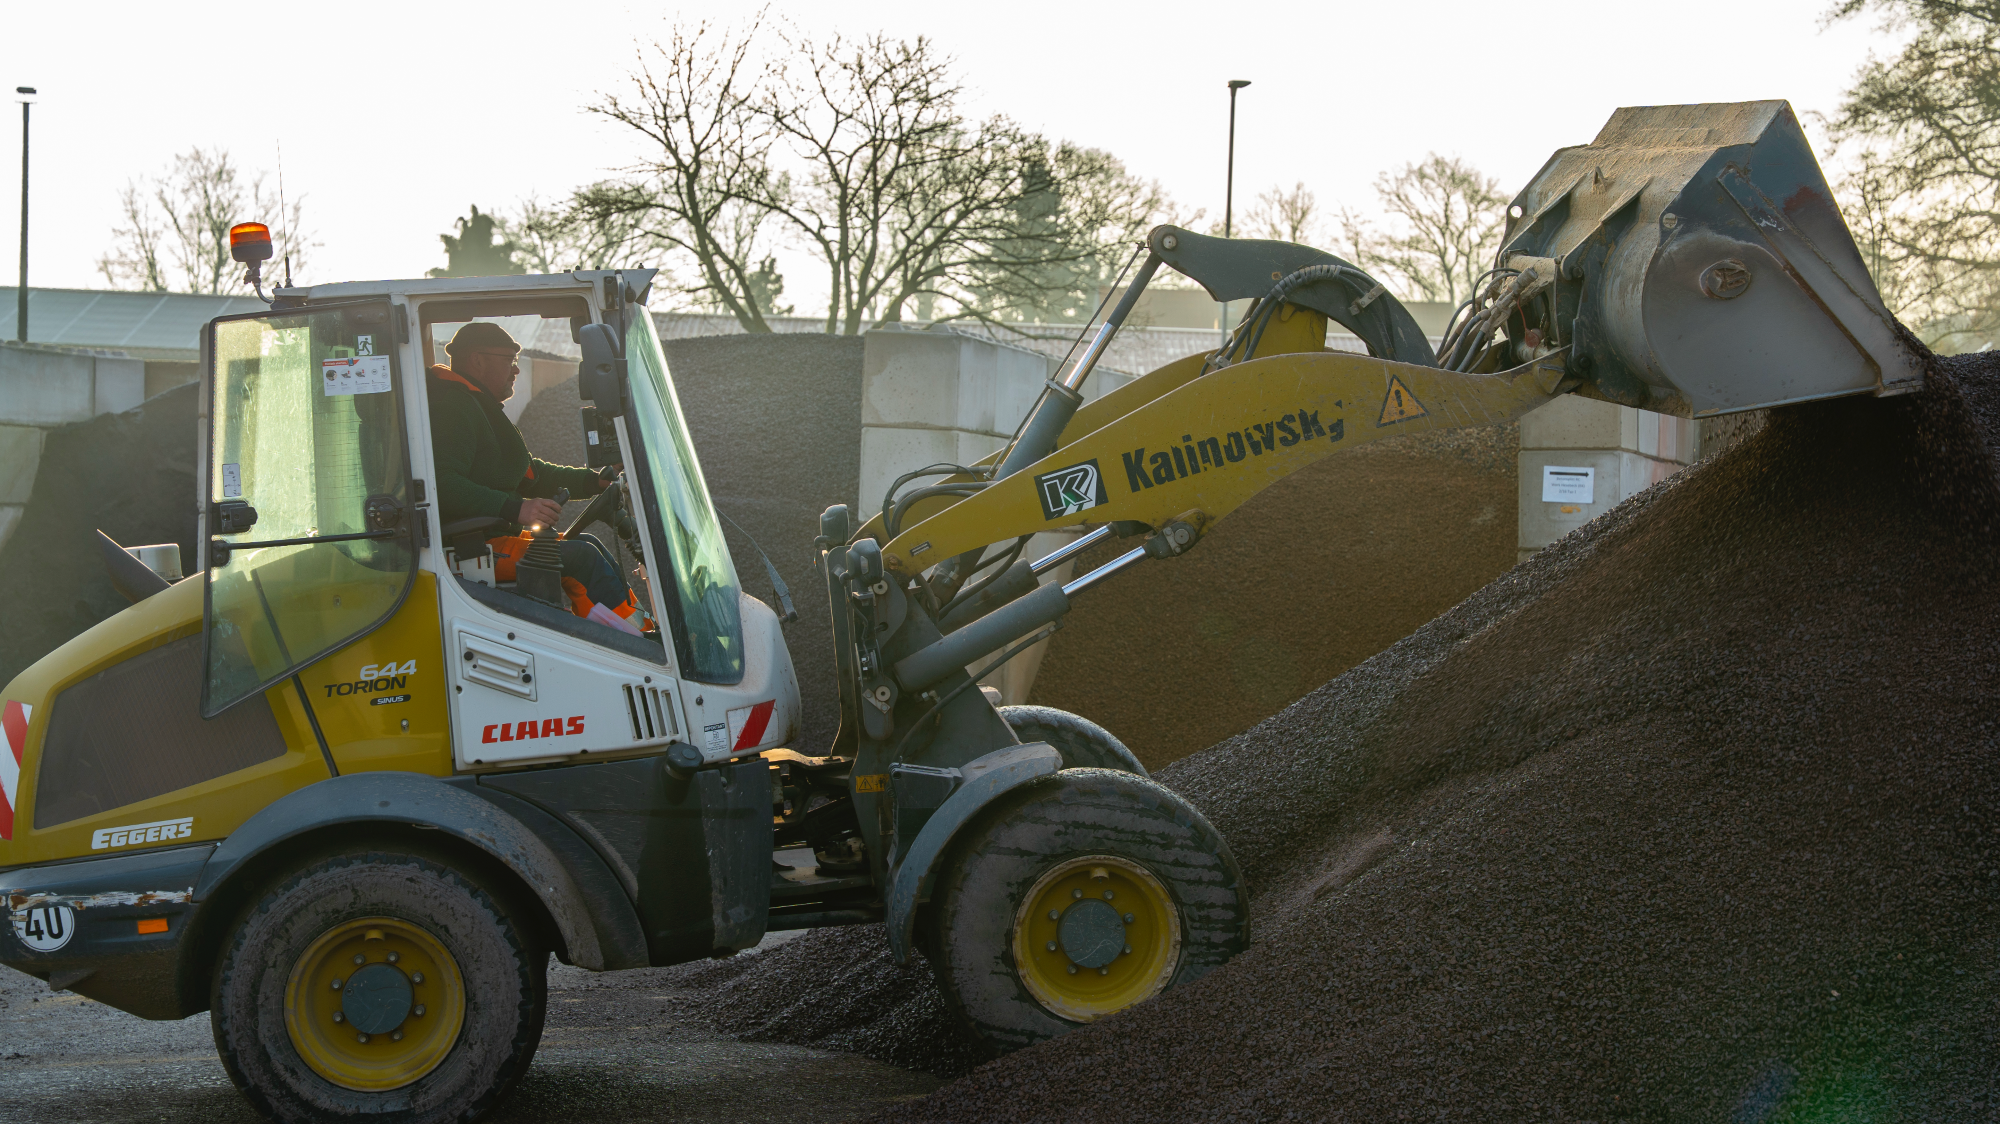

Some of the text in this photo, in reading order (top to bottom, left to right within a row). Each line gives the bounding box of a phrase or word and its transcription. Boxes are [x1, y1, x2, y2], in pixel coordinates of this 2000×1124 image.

[360, 659, 417, 681] 644
[324, 676, 407, 698] TORION
[377, 695, 404, 705] SINUS
[482, 715, 585, 744] CLAAS
[91, 816, 194, 850] EGGERS
[25, 907, 64, 941] 40
